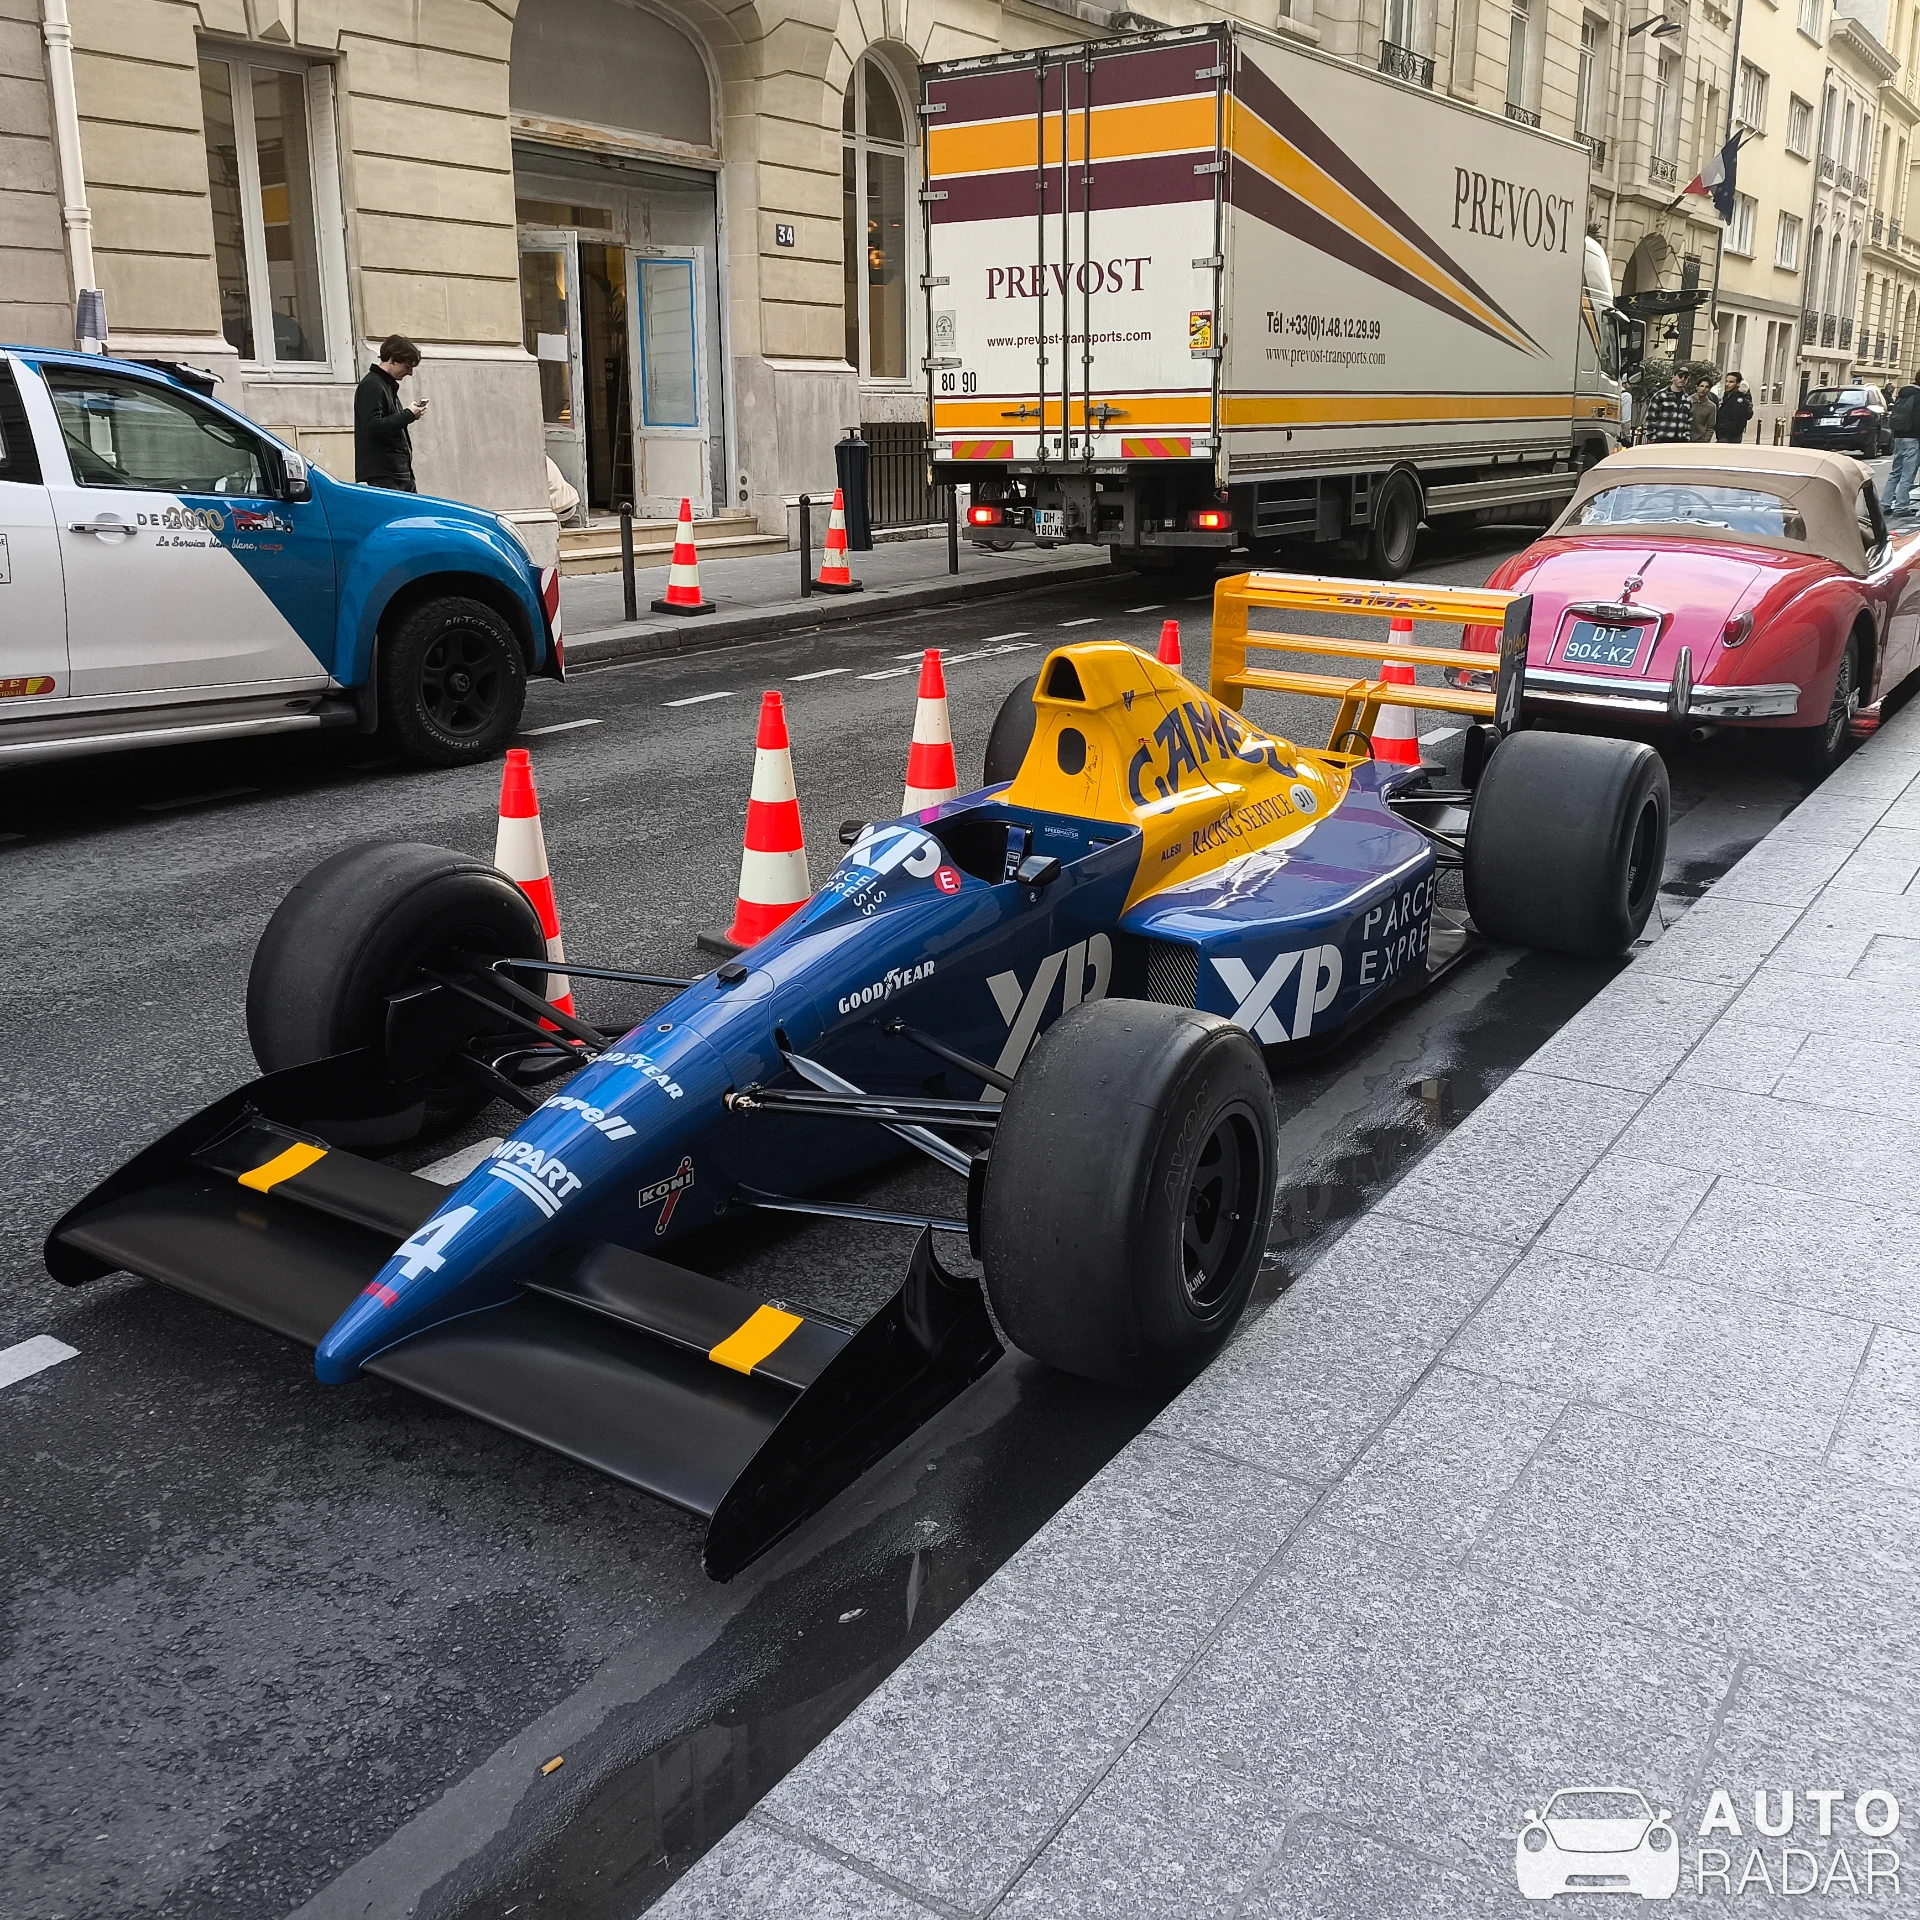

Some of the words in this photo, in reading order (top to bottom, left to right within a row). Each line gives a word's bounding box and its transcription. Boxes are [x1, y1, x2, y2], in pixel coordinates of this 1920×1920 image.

[1452, 166, 1574, 253] PREVOST
[778, 226, 793, 244] 34
[985, 256, 1152, 300] PREVOST
[987, 331, 1152, 348] www.prevost-transports.com
[1266, 311, 1283, 333] Tél
[1265, 348, 1386, 368] www.prevost-transports.com
[941, 373, 955, 391] 80
[962, 372, 976, 392] 90
[172, 536, 206, 548] Service
[1566, 642, 1635, 664] 904-KZ
[1501, 672, 1516, 732] 4
[1129, 701, 1298, 814] CAMEL
[1294, 790, 1314, 808] 311
[1191, 814, 1242, 857] RACING
[1238, 793, 1295, 832] SERVICE
[840, 825, 942, 879] XP
[1160, 842, 1182, 863] ALESI
[829, 869, 887, 903] RCELS
[1363, 873, 1434, 940] PARCE
[1359, 918, 1429, 985] EXPRE
[838, 960, 935, 1014] GOODYEAR
[1210, 944, 1343, 1045] XP
[540, 1094, 638, 1141] rrell
[642, 1173, 691, 1203] KONI
[392, 1204, 479, 1281] 4
